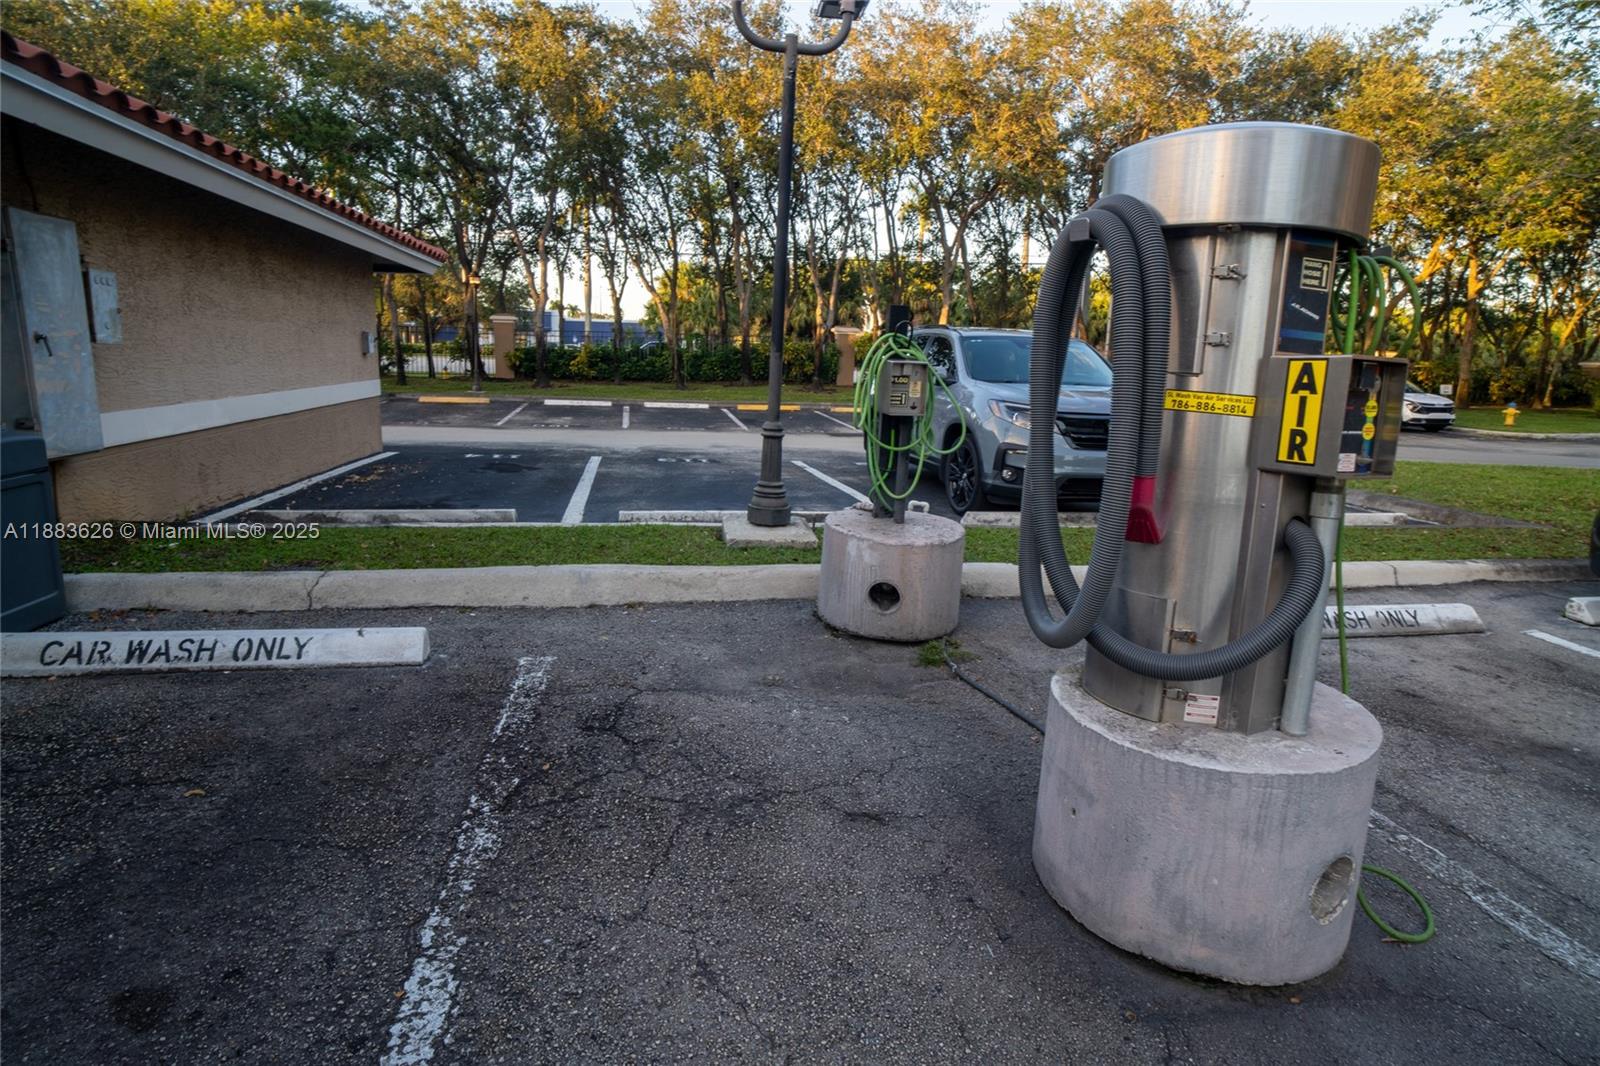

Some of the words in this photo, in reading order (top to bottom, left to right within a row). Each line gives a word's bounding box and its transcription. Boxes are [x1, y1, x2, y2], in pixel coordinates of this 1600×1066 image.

[1171, 399, 1247, 414] 786-886-8814
[1216, 395, 1242, 403] Services
[1287, 362, 1318, 462] AIR
[1375, 609, 1421, 628] ONLY
[39, 640, 113, 666] CAR
[124, 638, 218, 665] WASH
[231, 636, 314, 662] ONLY
